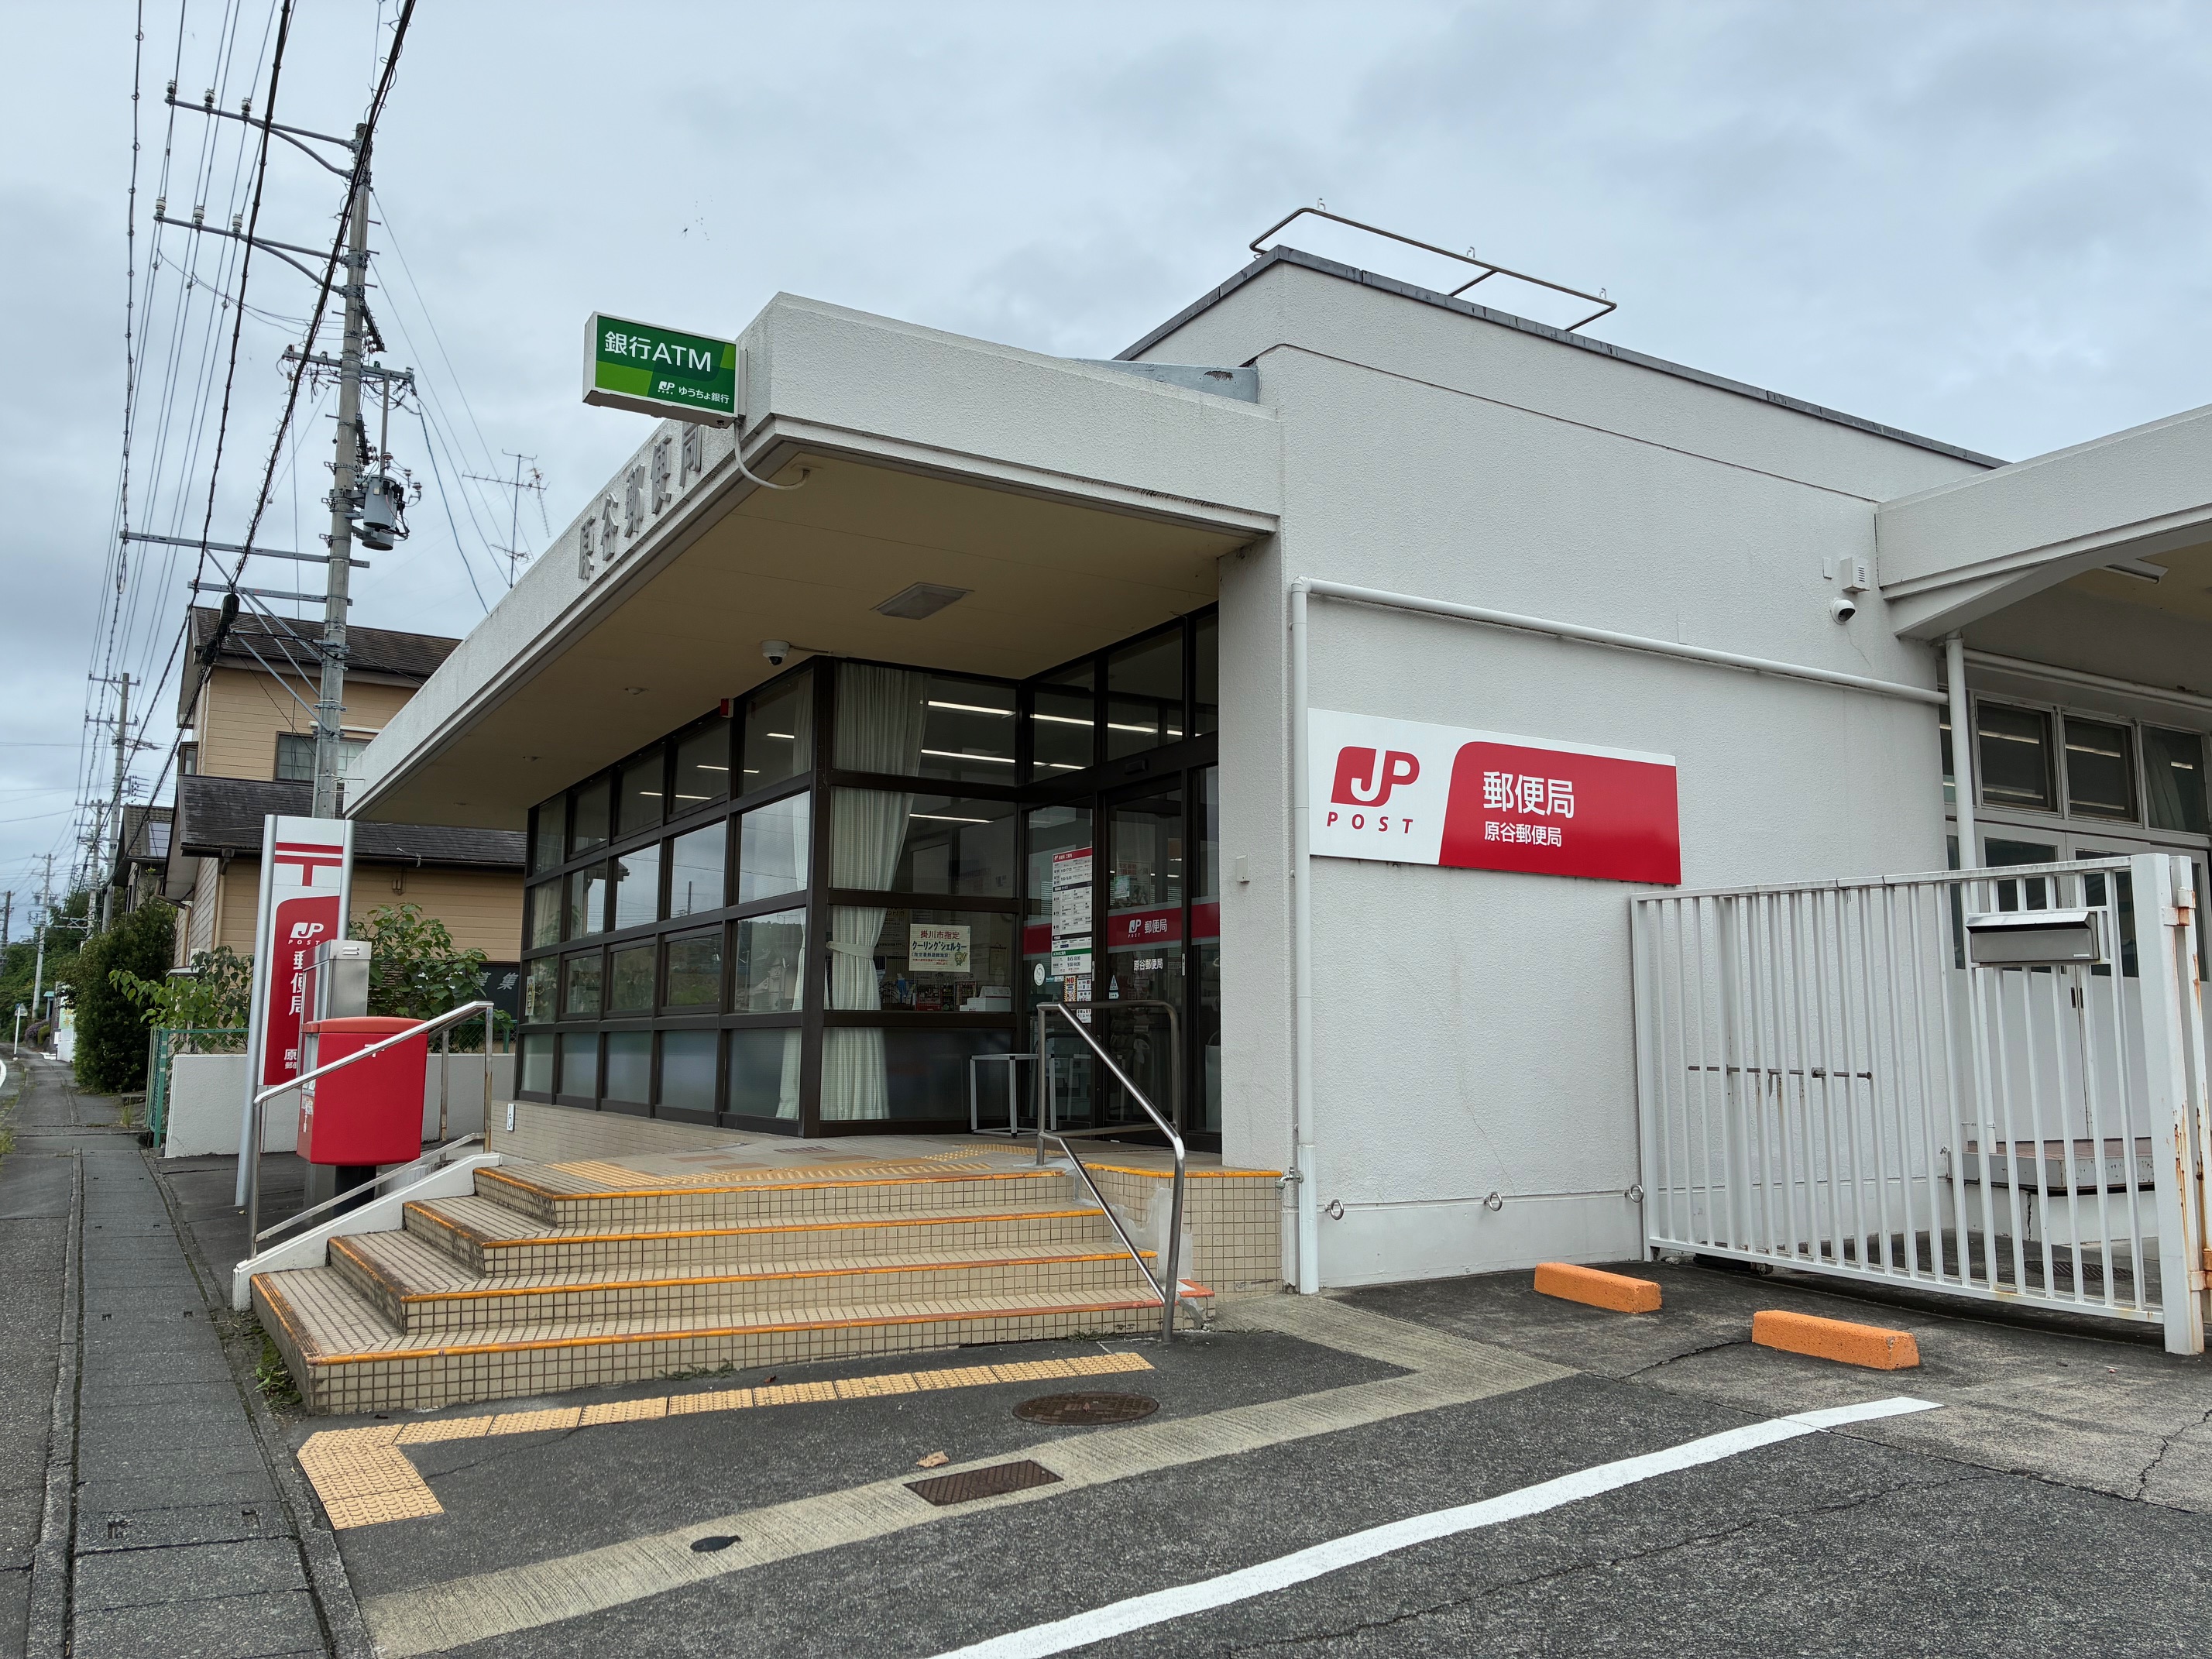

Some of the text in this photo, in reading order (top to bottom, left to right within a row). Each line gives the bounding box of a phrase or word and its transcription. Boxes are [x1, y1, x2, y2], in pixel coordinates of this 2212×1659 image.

[605, 331, 711, 372] 銀行ATM
[678, 386, 730, 404] ゆうちょ銀行
[1330, 745, 1420, 808] JP
[1482, 771, 1574, 819] 郵便局
[1327, 811, 1413, 834] POST
[1484, 820, 1562, 847] 原谷郵便局
[290, 922, 324, 939] JP
[920, 929, 960, 939] 掛川市指定
[1128, 919, 1142, 933] JP
[1144, 919, 1167, 934] 郵便局
[912, 940, 967, 951] クーリングシェルター
[1133, 957, 1163, 971] 原谷郵便局
